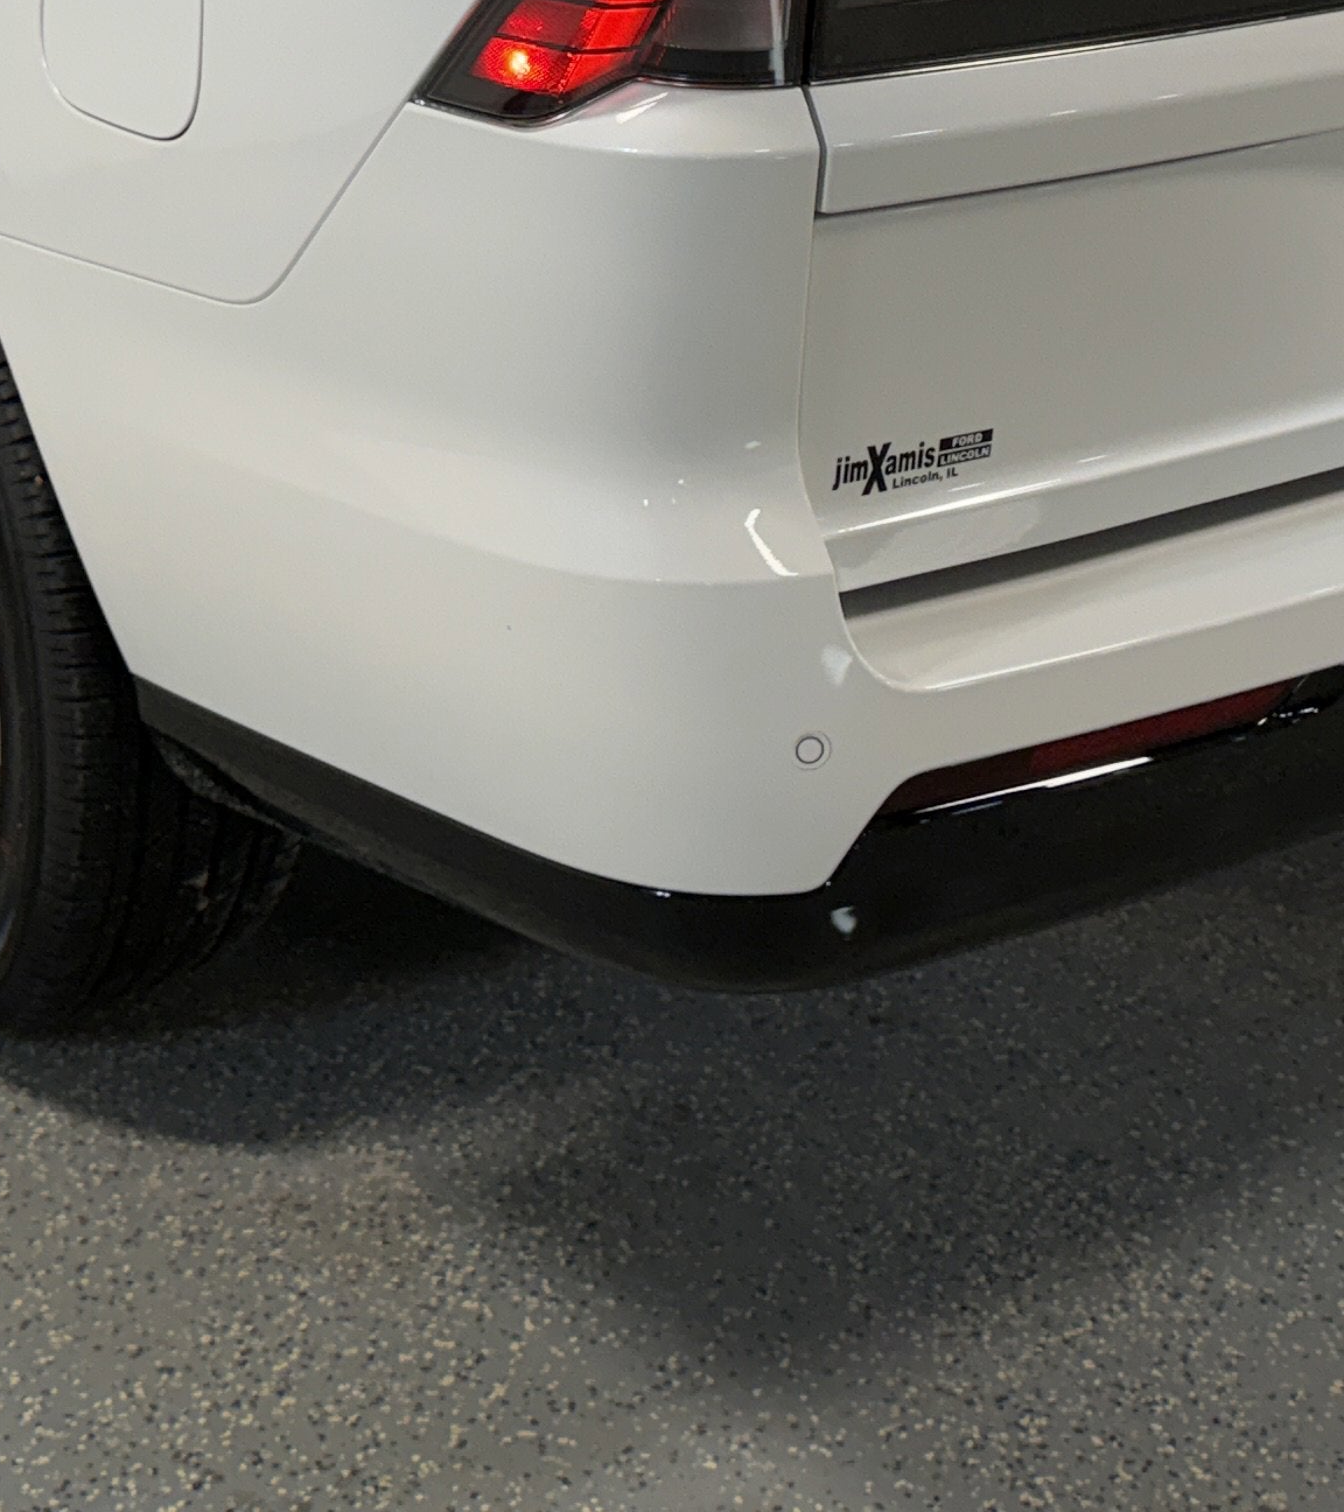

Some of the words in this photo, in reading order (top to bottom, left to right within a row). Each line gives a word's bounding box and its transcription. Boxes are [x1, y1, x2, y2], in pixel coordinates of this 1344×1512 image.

[951, 433, 983, 448] FORD
[939, 447, 990, 466] LINCOLN
[891, 469, 944, 489] Lincoln,
[946, 466, 959, 479] IL
